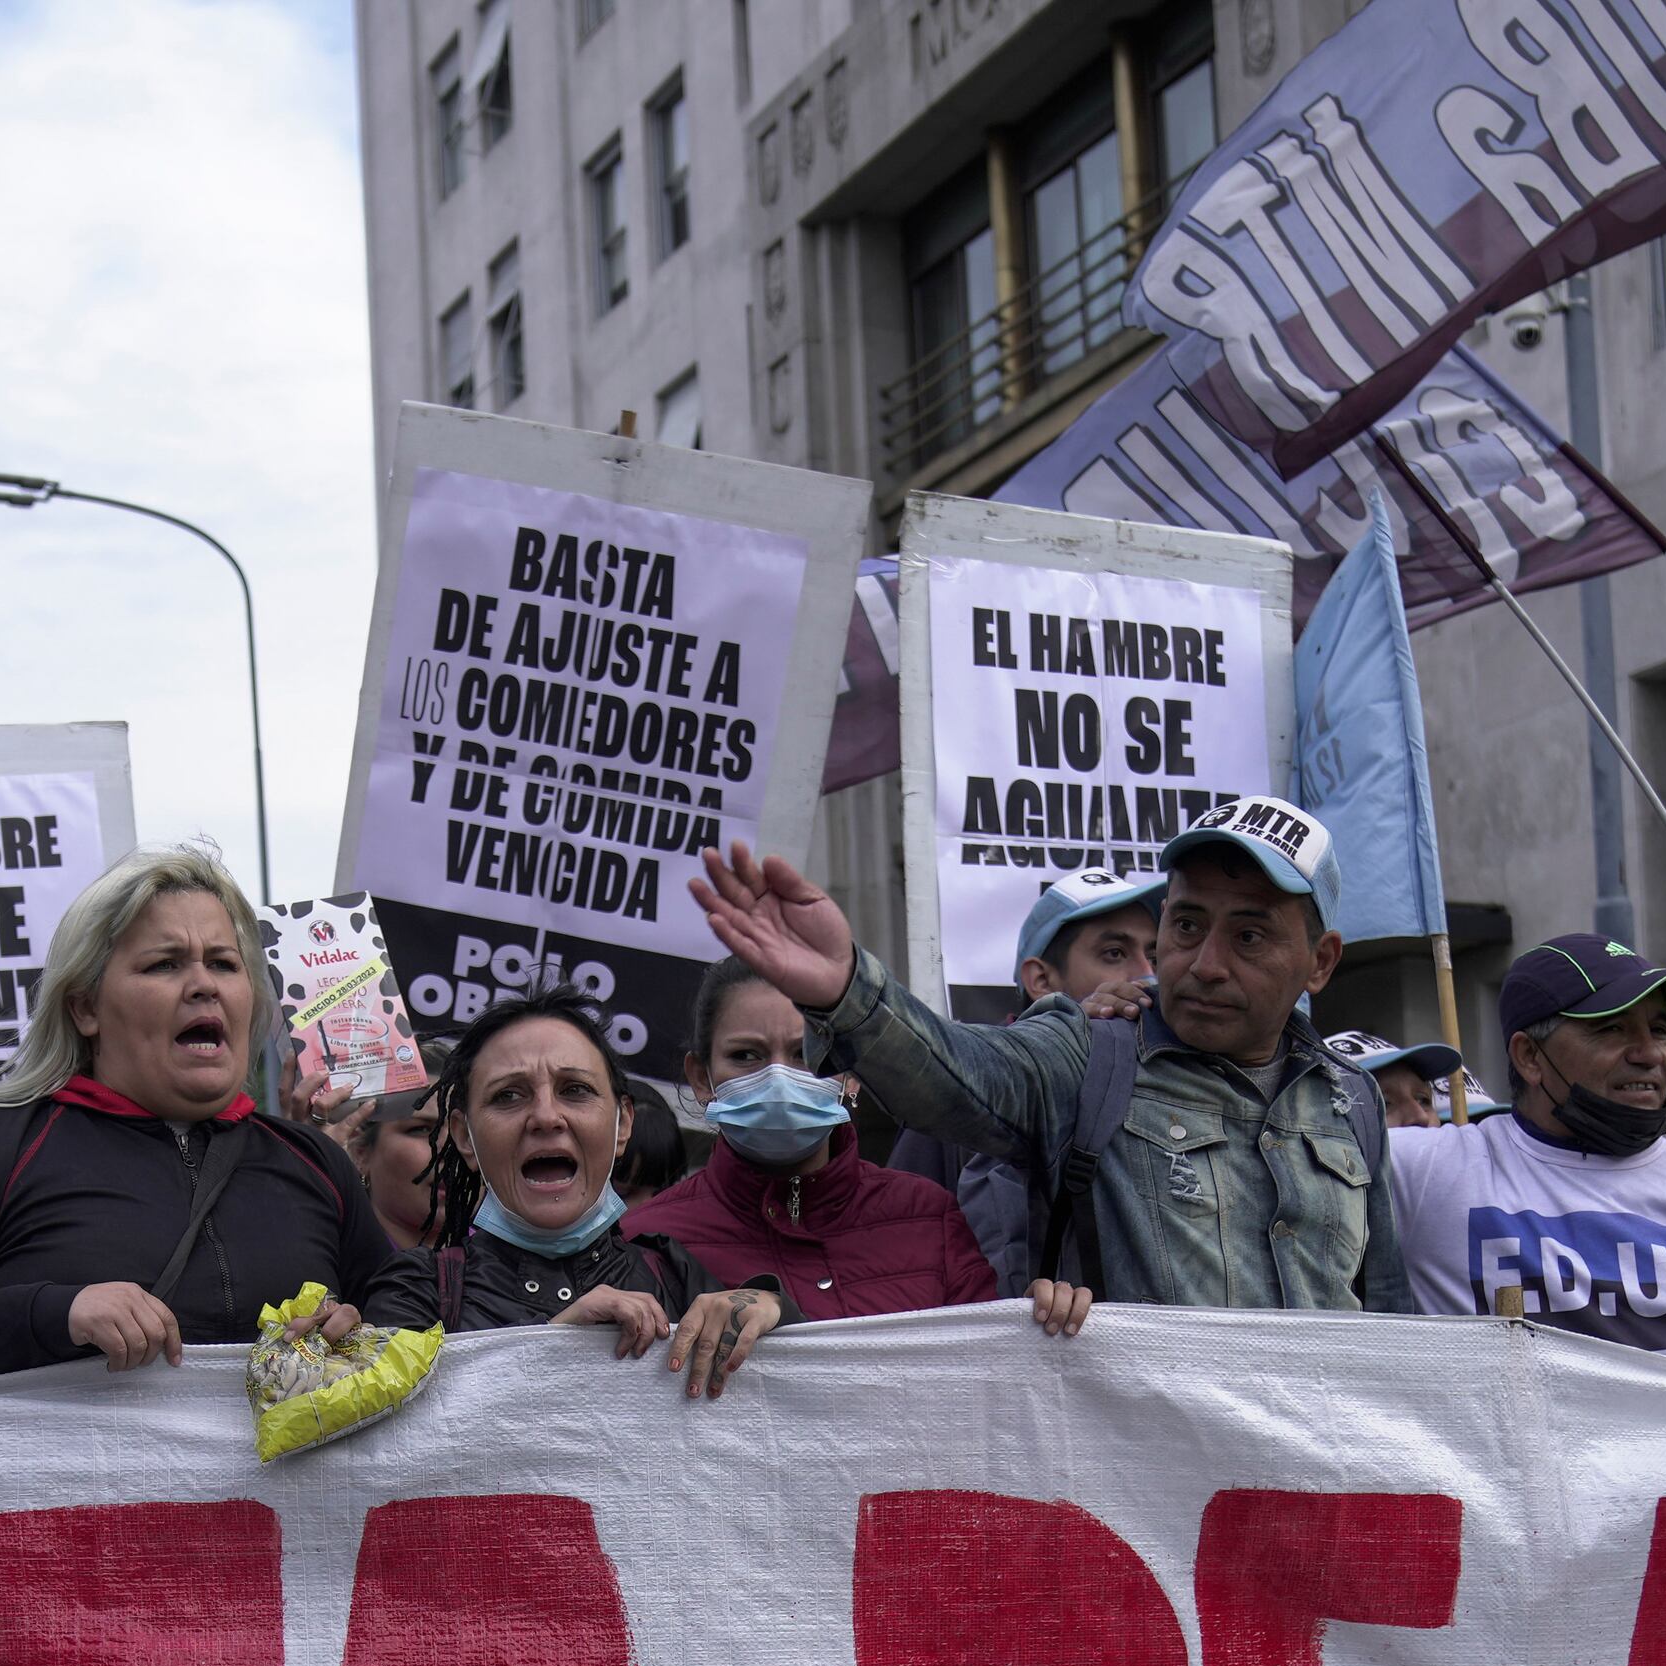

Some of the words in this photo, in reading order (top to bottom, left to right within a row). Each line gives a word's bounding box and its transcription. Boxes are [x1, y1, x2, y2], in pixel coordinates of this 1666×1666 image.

[509, 525, 675, 620] BASTA
[433, 587, 497, 661] DE
[504, 602, 694, 698] AJUSTE
[704, 641, 741, 707] A
[972, 607, 1017, 669] EL
[1029, 612, 1226, 687] HAMBRE
[400, 656, 450, 725] LOS
[456, 666, 756, 784] COMEDORES
[1014, 689, 1101, 773] NO
[1125, 697, 1195, 777] SE
[409, 731, 445, 804] Y
[450, 740, 520, 818] DE
[523, 754, 724, 857] COMIDA
[960, 775, 1241, 873] AGUANT
[1238, 803, 1310, 849] MTR
[446, 820, 659, 923] VENCIDA
[1232, 824, 1246, 832] 12
[1246, 828, 1265, 837] DE
[1264, 833, 1298, 861] ABRIL
[299, 948, 360, 968] Vidalac
[300, 994, 337, 1022] VENCIDO
[336, 966, 377, 996] 28/03/2023
[452, 934, 616, 1003] POLO
